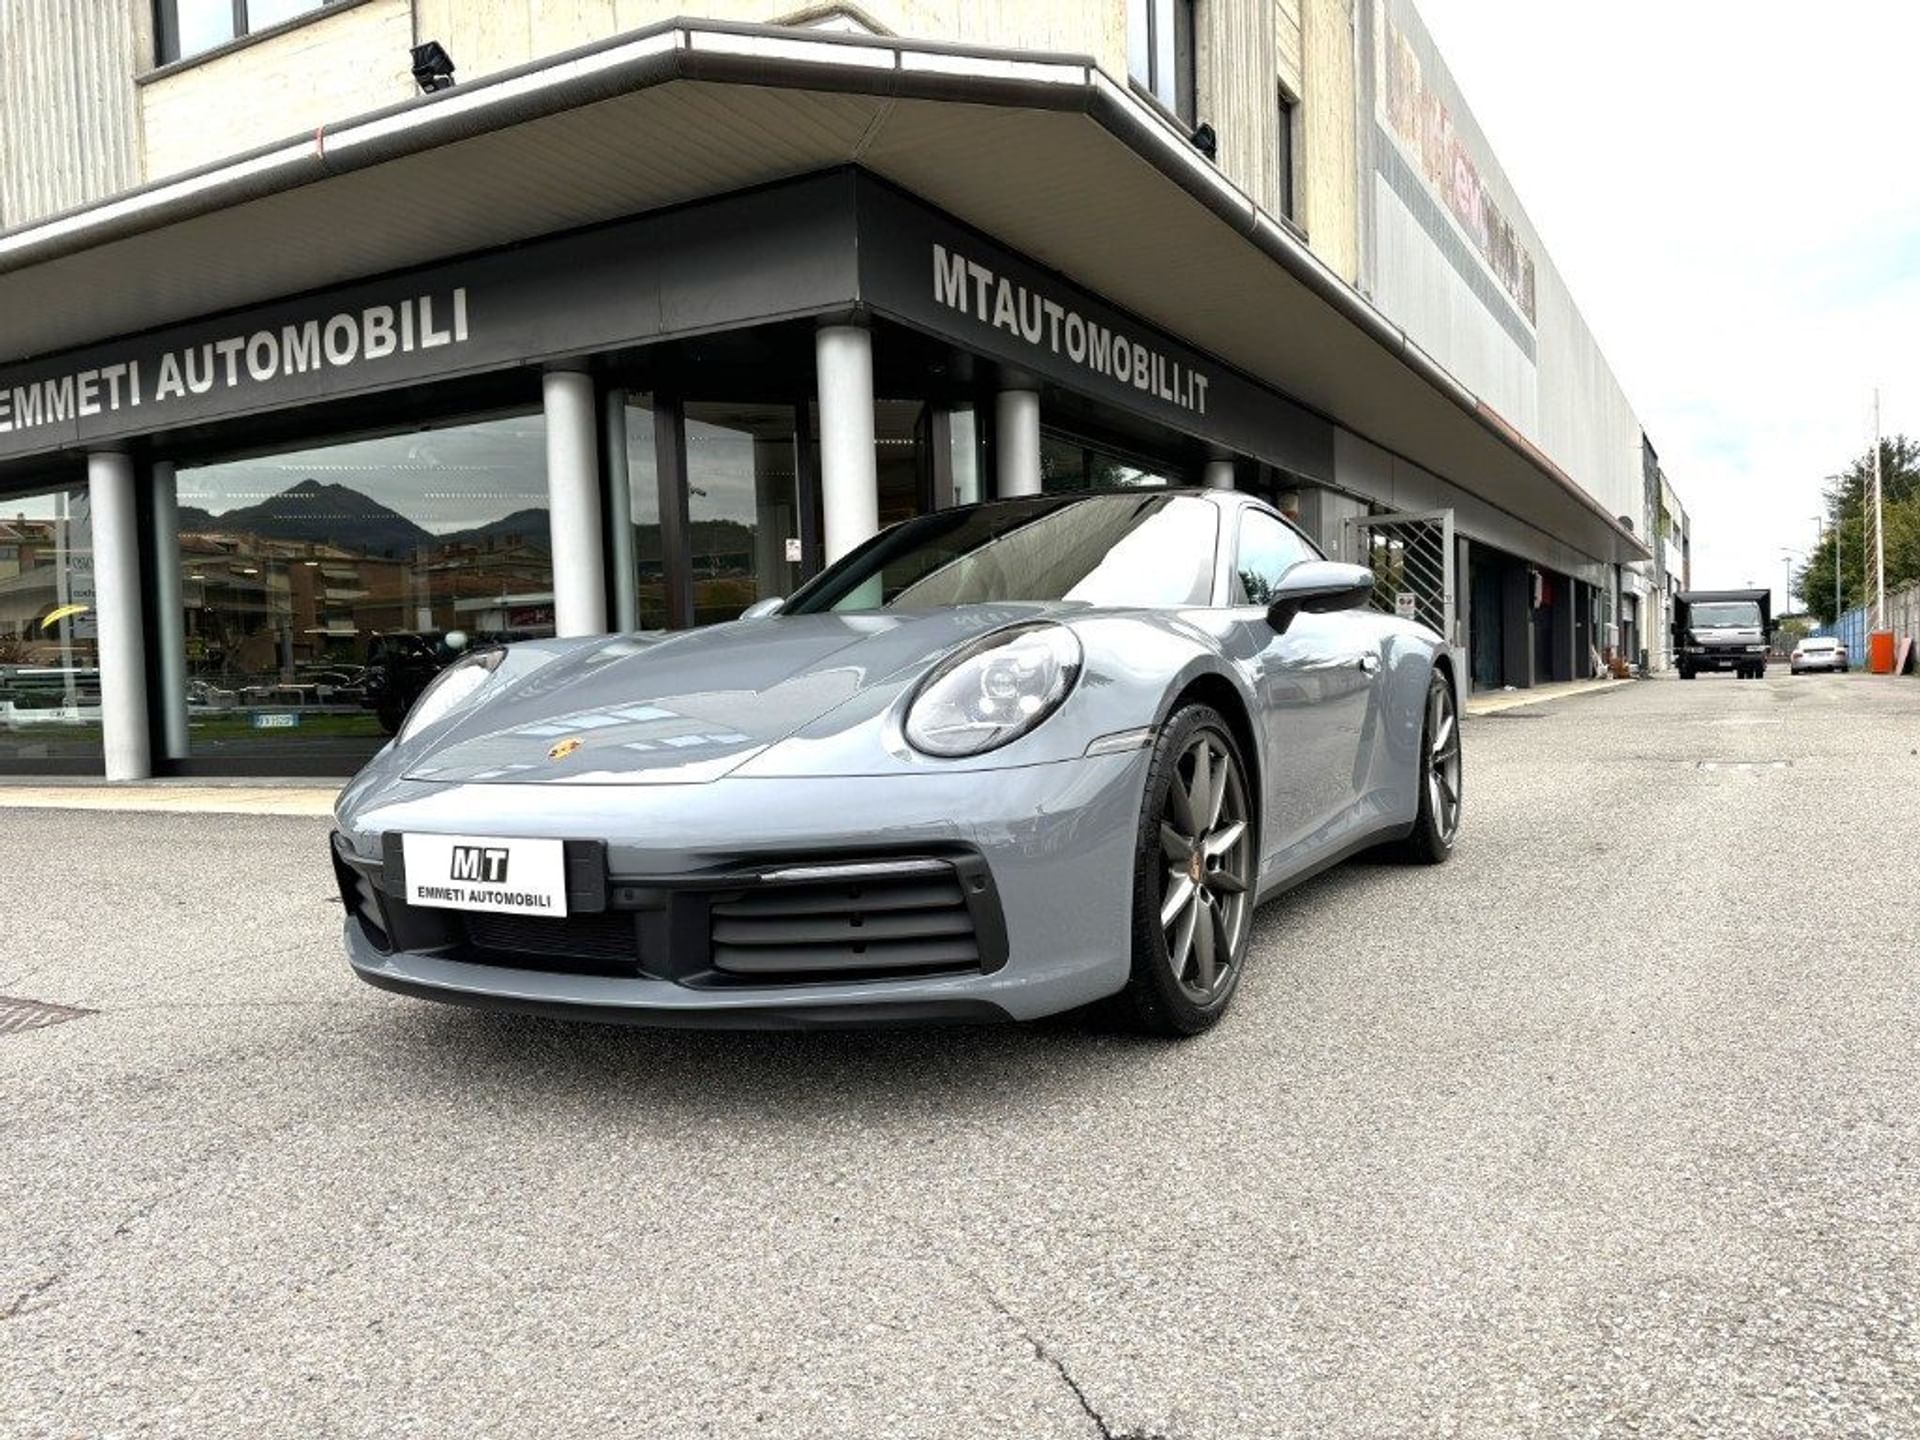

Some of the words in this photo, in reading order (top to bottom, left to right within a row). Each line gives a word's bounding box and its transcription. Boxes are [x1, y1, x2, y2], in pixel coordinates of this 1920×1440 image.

[0, 360, 140, 432] EMMETI
[155, 288, 470, 401] AUTOMOBILI
[933, 243, 1208, 414] MTAUTOMOBILI.IT
[418, 886, 464, 902] EMMETI
[469, 889, 551, 908] AUTOMOBILI
[451, 846, 509, 882] MT
